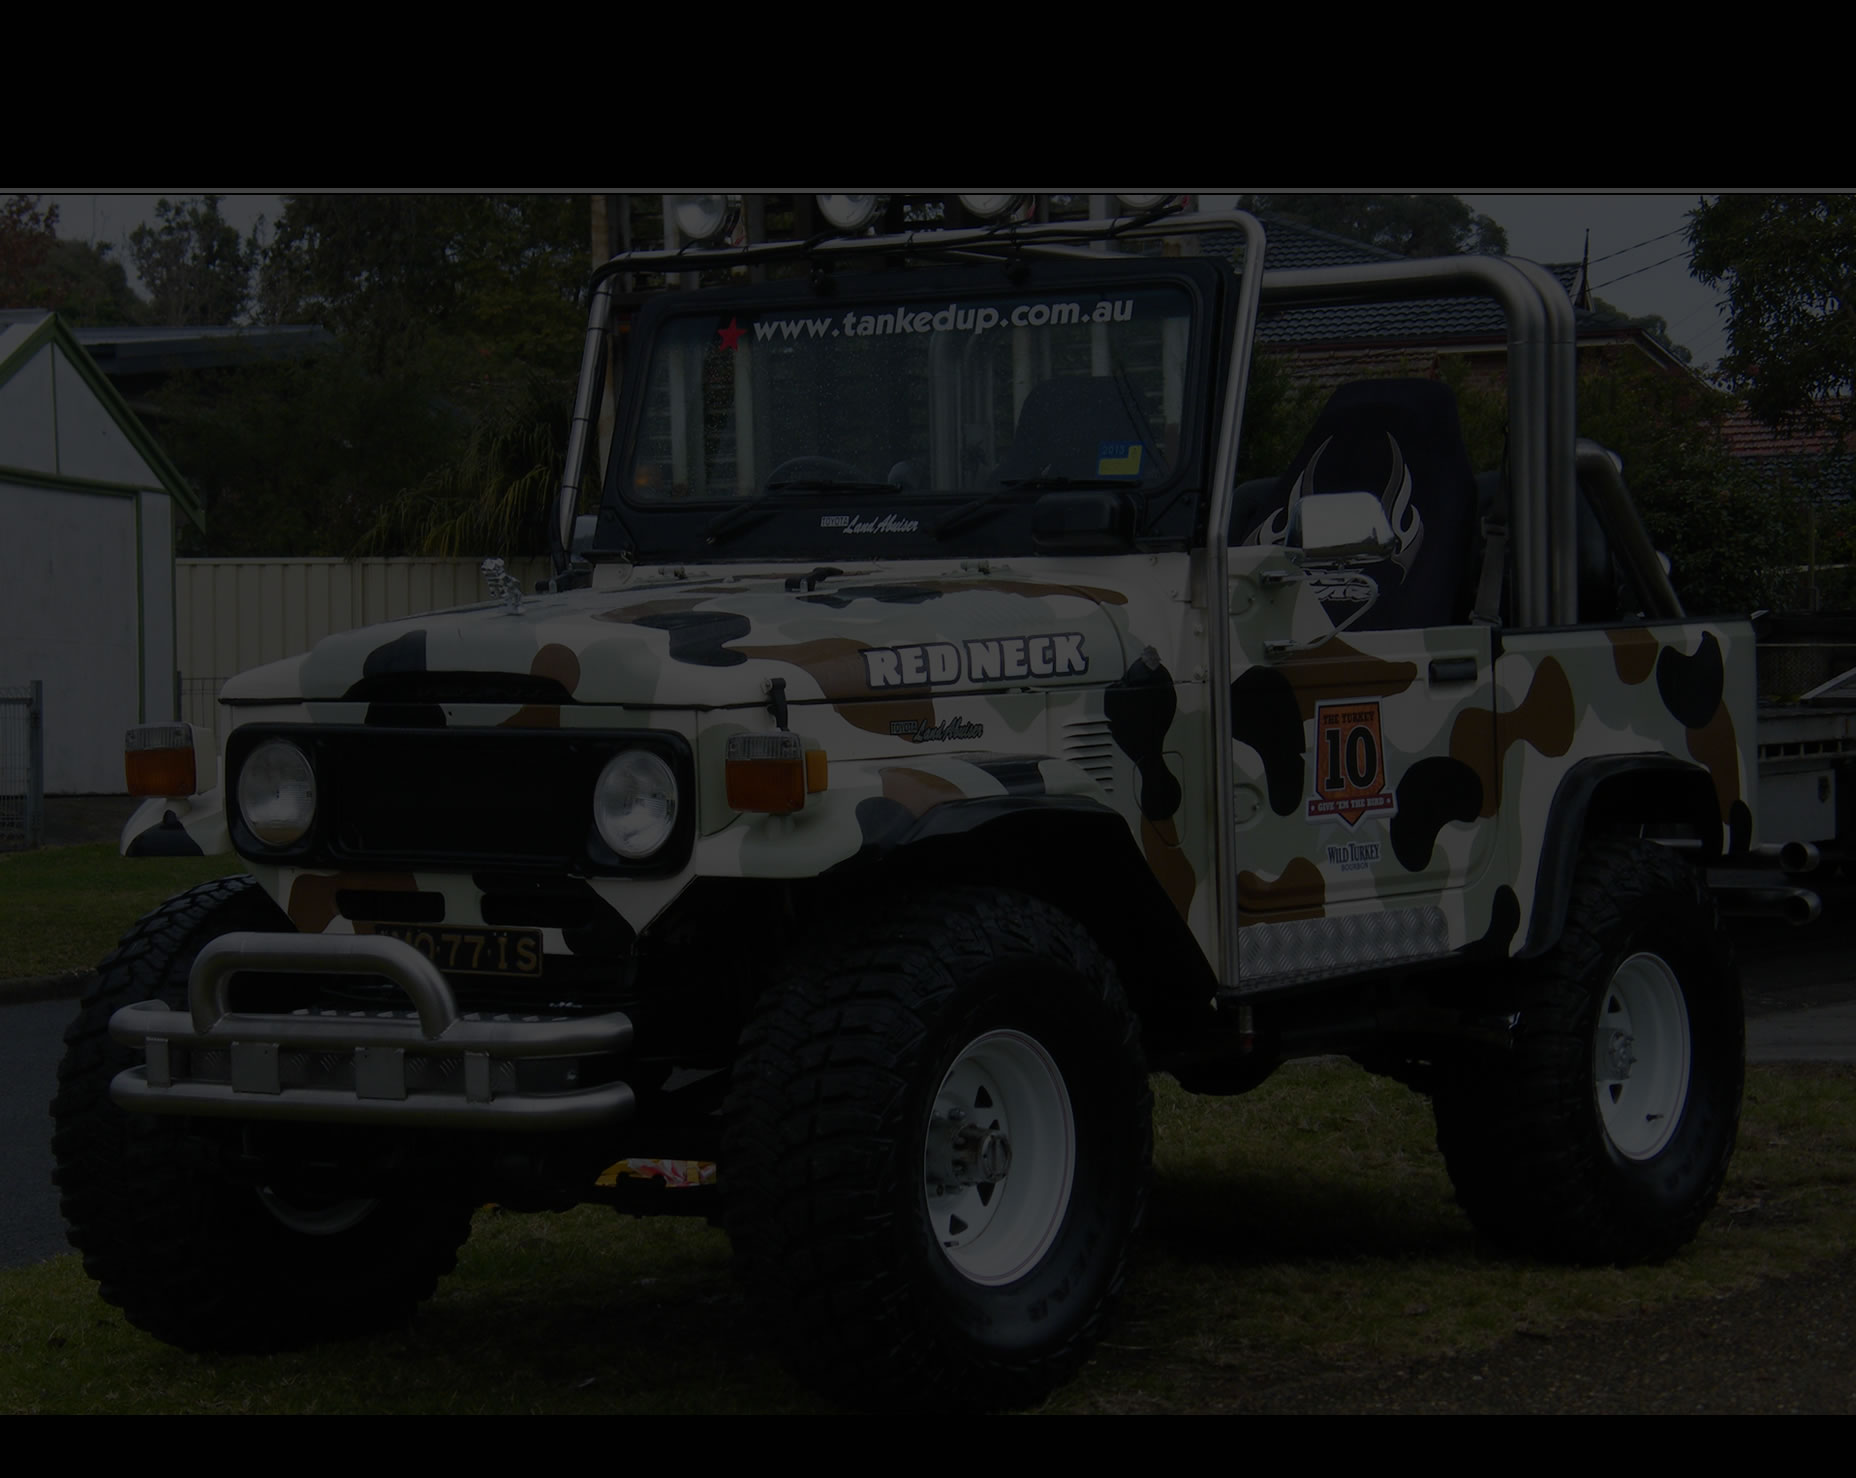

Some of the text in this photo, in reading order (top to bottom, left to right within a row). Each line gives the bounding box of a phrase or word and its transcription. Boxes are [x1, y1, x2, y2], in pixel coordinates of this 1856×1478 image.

[752, 298, 1135, 342] www.tankedup.com.au
[820, 515, 850, 528] TOYOTA
[859, 632, 1089, 690] RED NECK
[1323, 711, 1375, 725] THE TURKEY
[890, 720, 919, 736] TOYOTA
[1324, 725, 1379, 791] 10
[1317, 801, 1335, 812] GIVE
[1350, 799, 1365, 808] THE
